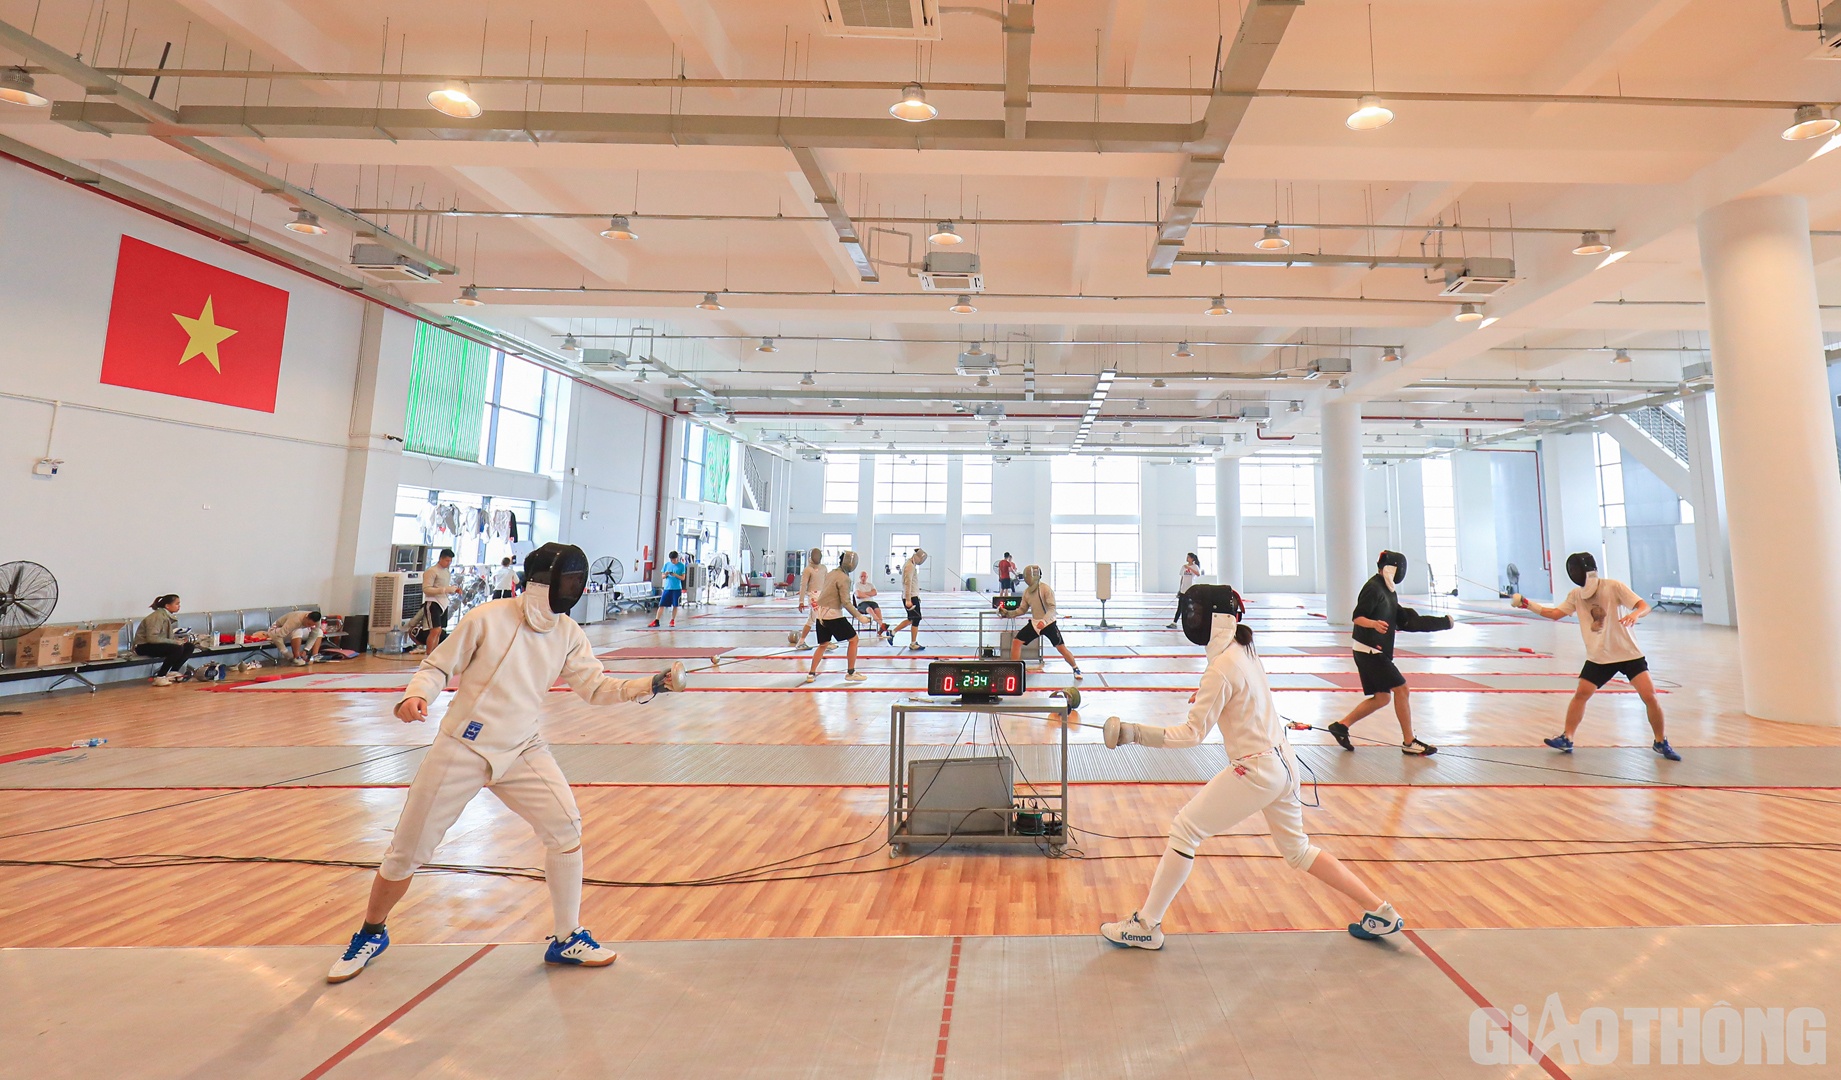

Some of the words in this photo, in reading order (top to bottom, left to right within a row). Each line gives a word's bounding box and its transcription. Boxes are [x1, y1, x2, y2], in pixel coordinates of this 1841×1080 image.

[943, 676, 953, 692] 0
[963, 675, 988, 687] 2:34
[1006, 676, 1015, 692] 0
[1121, 931, 1152, 943] Kempa
